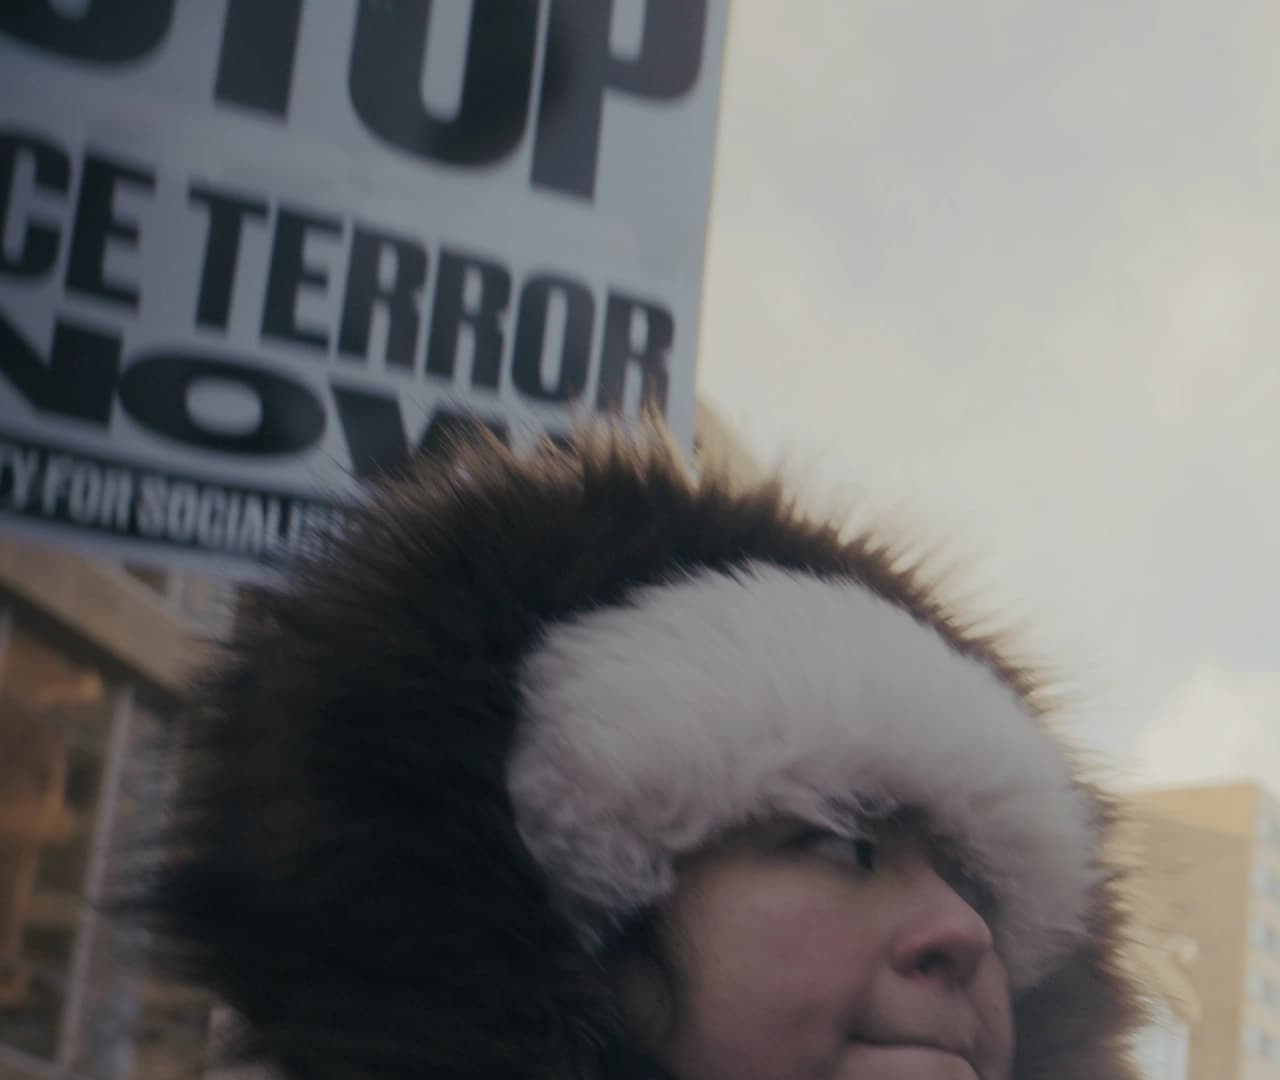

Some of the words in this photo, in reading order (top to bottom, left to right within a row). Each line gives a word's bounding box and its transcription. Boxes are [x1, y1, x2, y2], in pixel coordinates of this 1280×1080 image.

[0, 0, 706, 203] OP
[188, 178, 675, 422] TERROR
[42, 454, 133, 530] FOR
